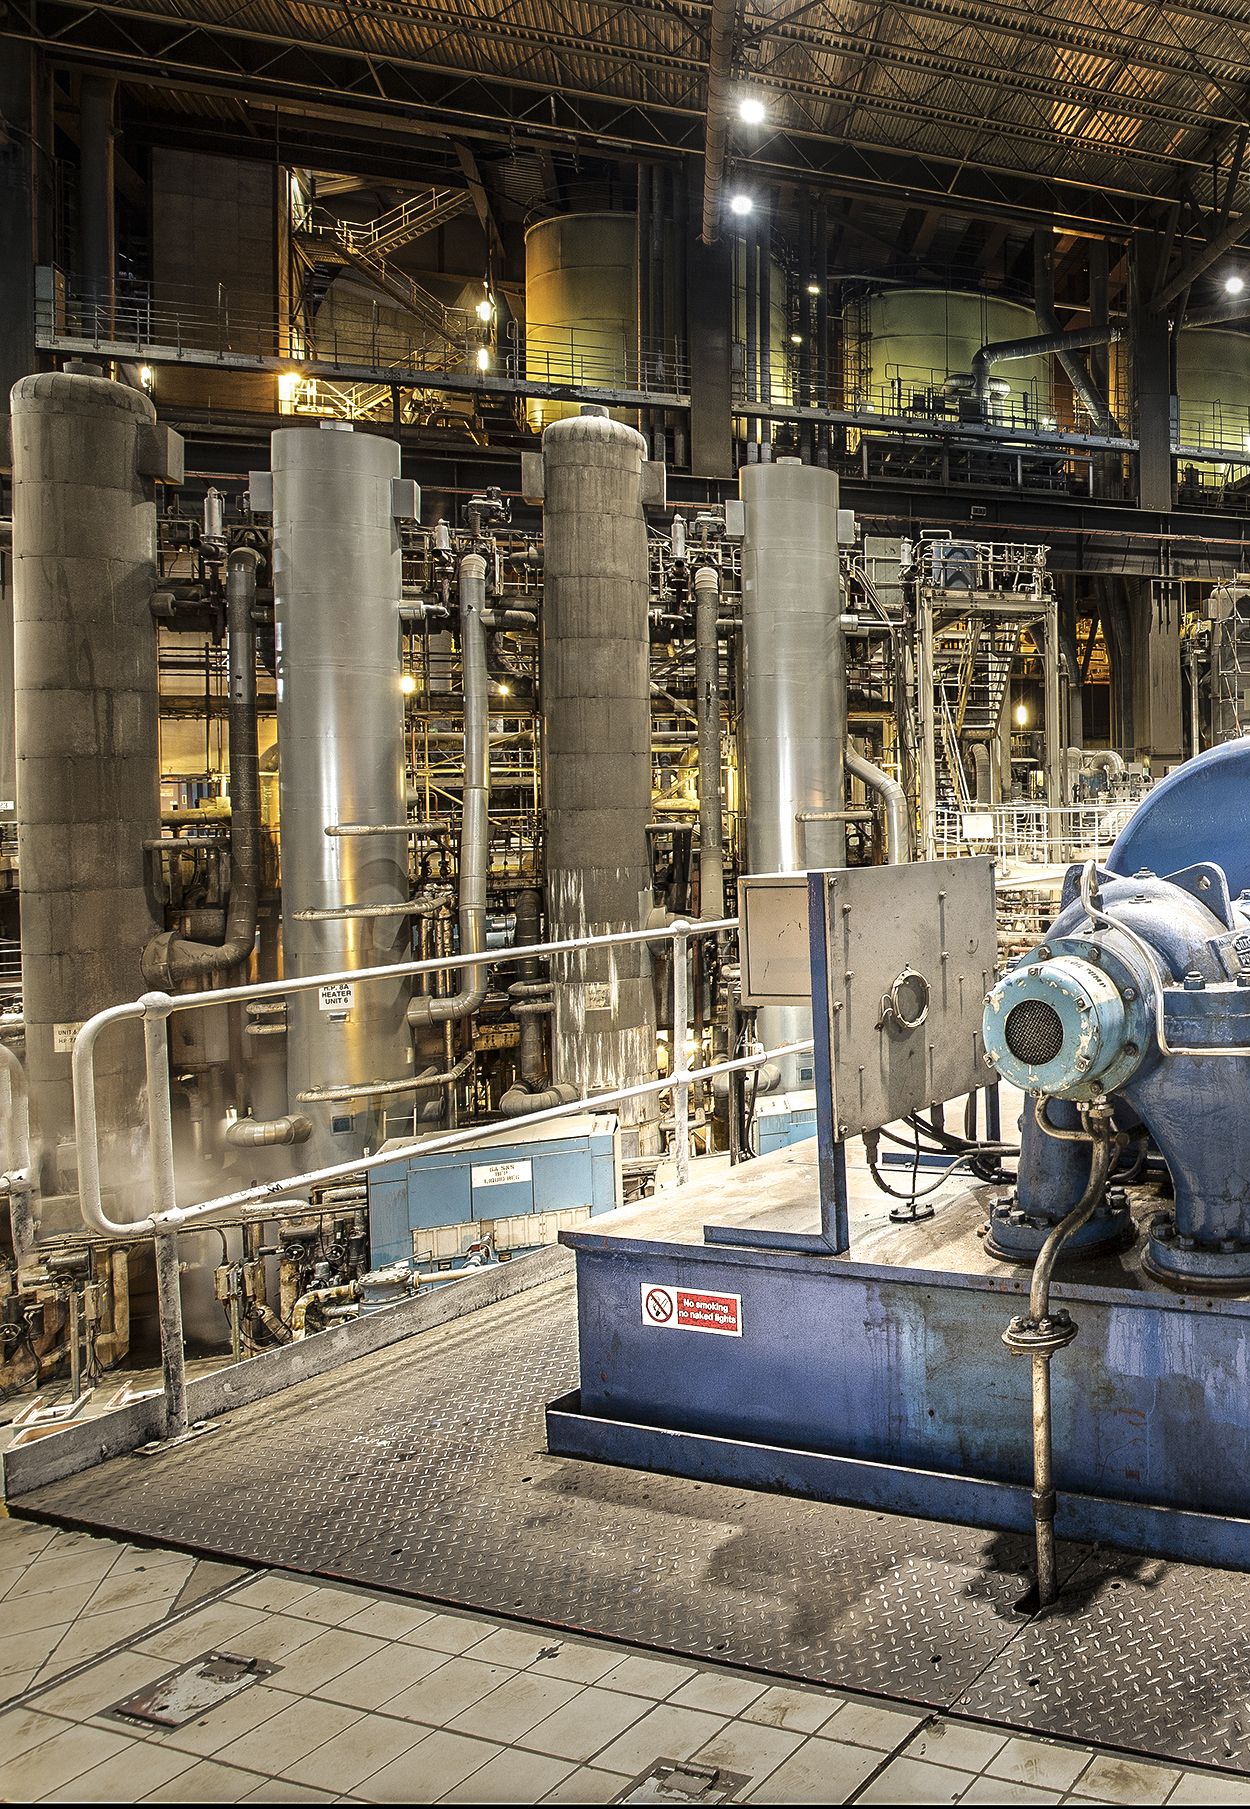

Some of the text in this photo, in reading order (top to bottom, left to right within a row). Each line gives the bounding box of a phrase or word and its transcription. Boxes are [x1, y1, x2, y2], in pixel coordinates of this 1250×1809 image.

[321, 990, 352, 998] HEATER
[683, 1298, 729, 1314] No smoking
[678, 1310, 736, 1325] no naked lights
